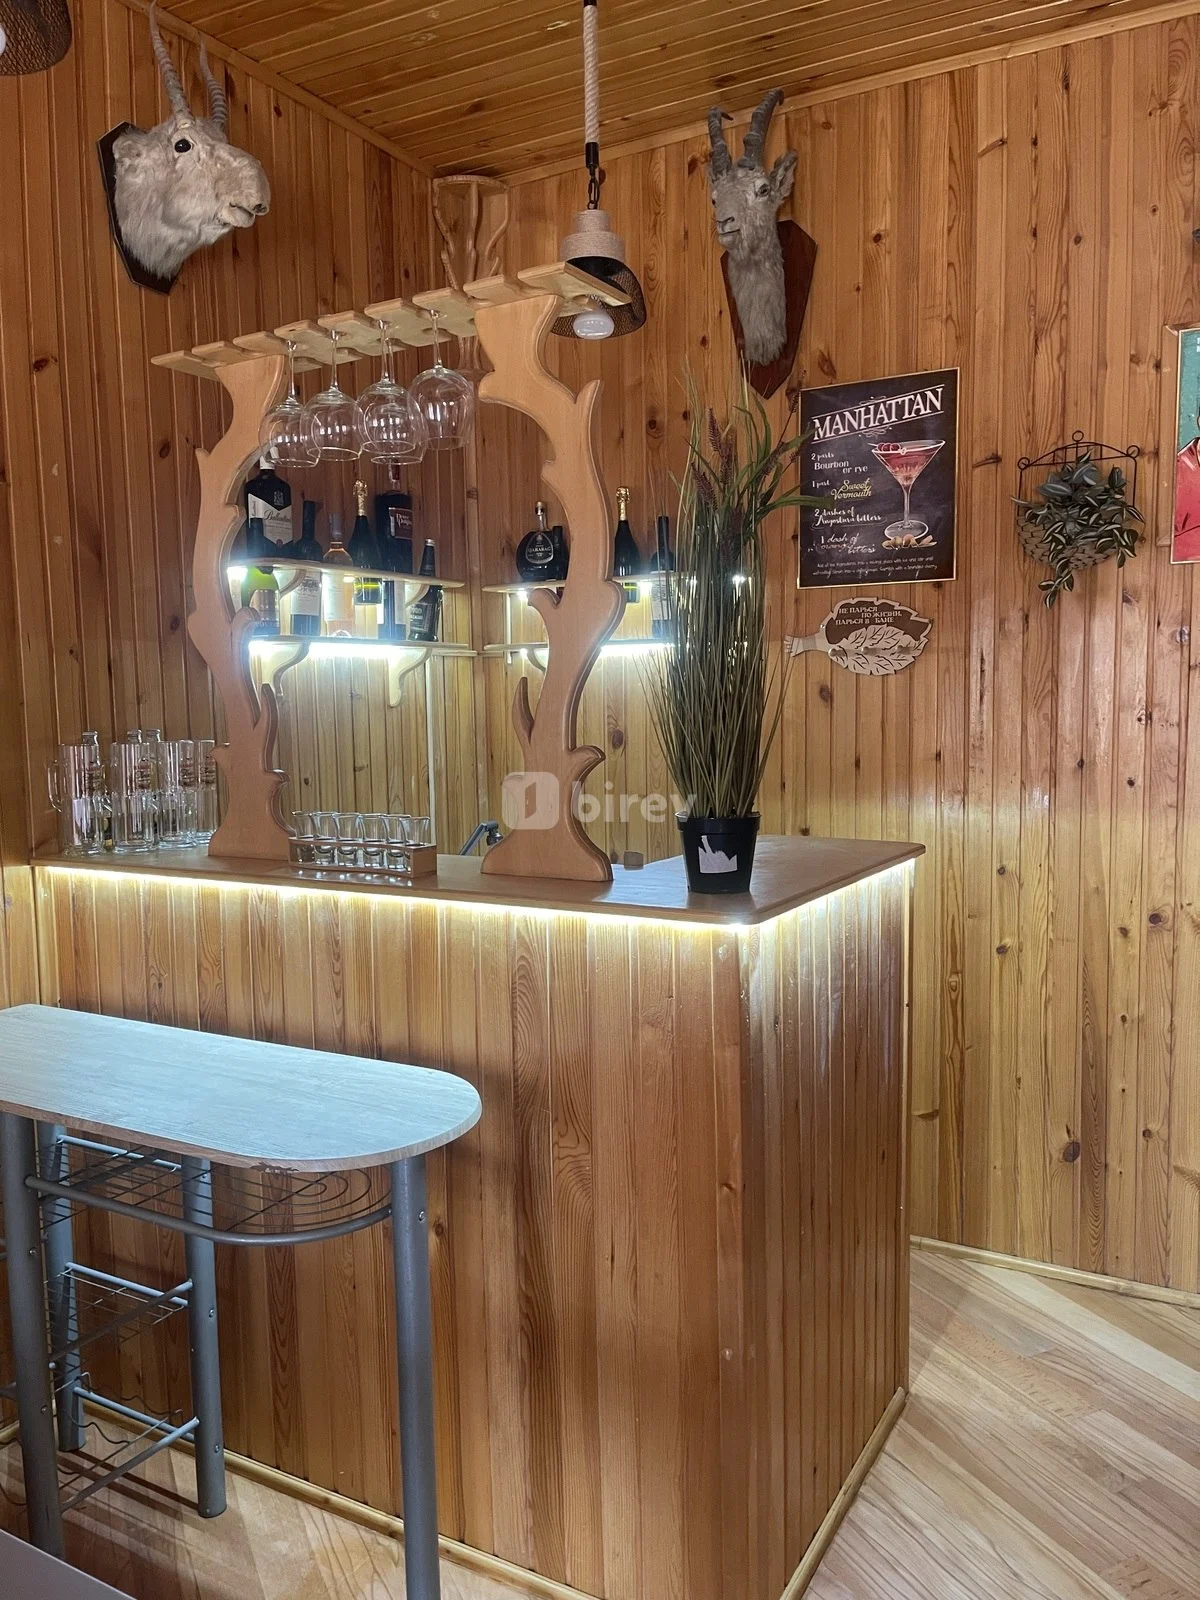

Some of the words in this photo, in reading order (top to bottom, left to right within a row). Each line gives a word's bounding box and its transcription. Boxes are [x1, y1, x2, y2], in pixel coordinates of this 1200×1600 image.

[813, 388, 943, 440] MANHATTAN
[814, 461, 849, 470] Bourbon
[854, 466, 868, 474] rye
[841, 478, 870, 492] Sweet
[831, 486, 872, 500] Vermouth
[821, 508, 846, 516] dashes
[847, 506, 855, 517] of
[827, 533, 848, 543] dash
[849, 533, 859, 544] of
